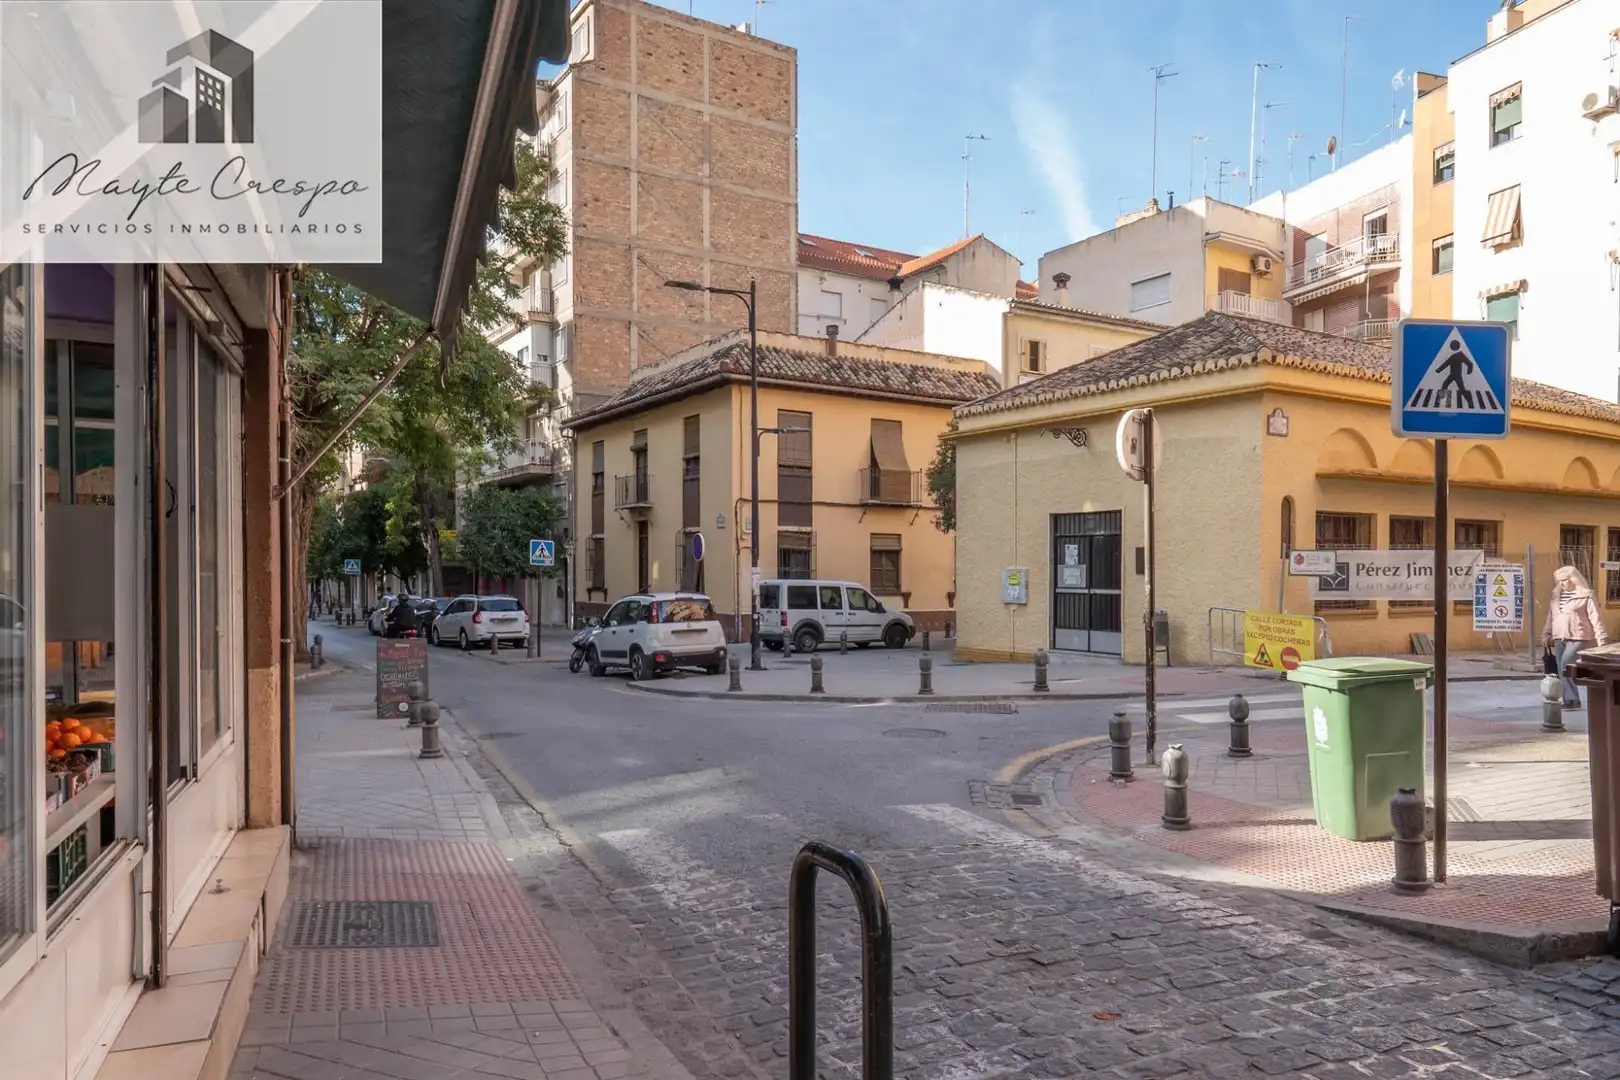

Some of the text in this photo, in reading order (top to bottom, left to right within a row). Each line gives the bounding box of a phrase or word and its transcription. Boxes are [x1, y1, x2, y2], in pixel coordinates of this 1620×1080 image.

[1355, 561, 1401, 577] Pérez
[1250, 615, 1303, 627] CALLE CORTADA
[1259, 624, 1296, 635] POR OBRAS
[1274, 635, 1311, 646] COCHERAS
